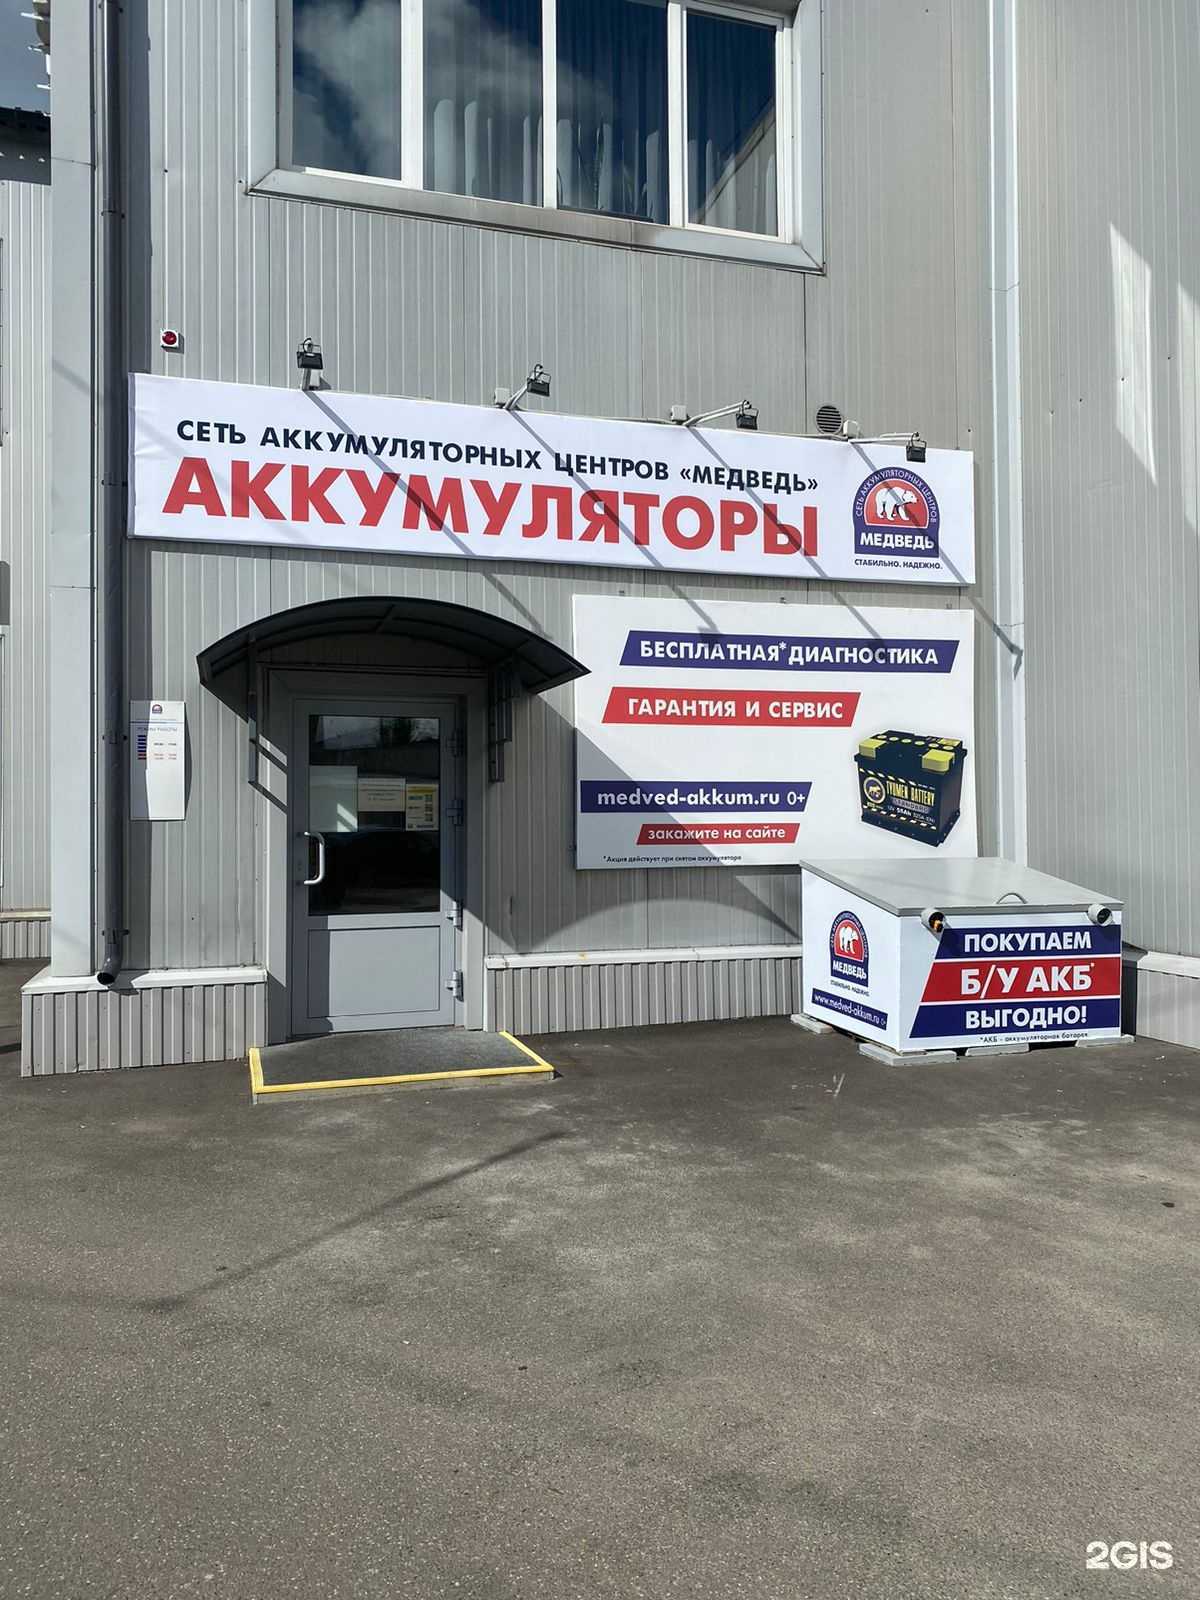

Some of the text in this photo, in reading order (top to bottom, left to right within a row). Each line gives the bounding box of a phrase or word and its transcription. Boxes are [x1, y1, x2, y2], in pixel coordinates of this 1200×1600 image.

[176, 419, 819, 495] СЕТЬ АККУМУЛЯТОРНЫХ ЦЕНТРОВ «МЕДВЕДЬ»
[161, 456, 819, 557] АККУМУЛЯТОРЫ
[859, 532, 935, 550] МЕДВЕДЬ
[854, 558, 902, 568] СТАБИЛЬНО.
[788, 645, 939, 666] ДИАГНОСТИКА
[627, 697, 844, 720] ГАРАНТИЯ И СЕРВИС
[597, 788, 806, 806] medved-akkum.ru 0+
[647, 825, 786, 841] закажите на сайте
[964, 931, 1092, 953] ПОКУПАЕМ
[832, 960, 867, 980] МЕДВЕДЬ
[961, 964, 1020, 999] Б/У
[965, 1006, 1088, 1029] ВЫГОДНО!
